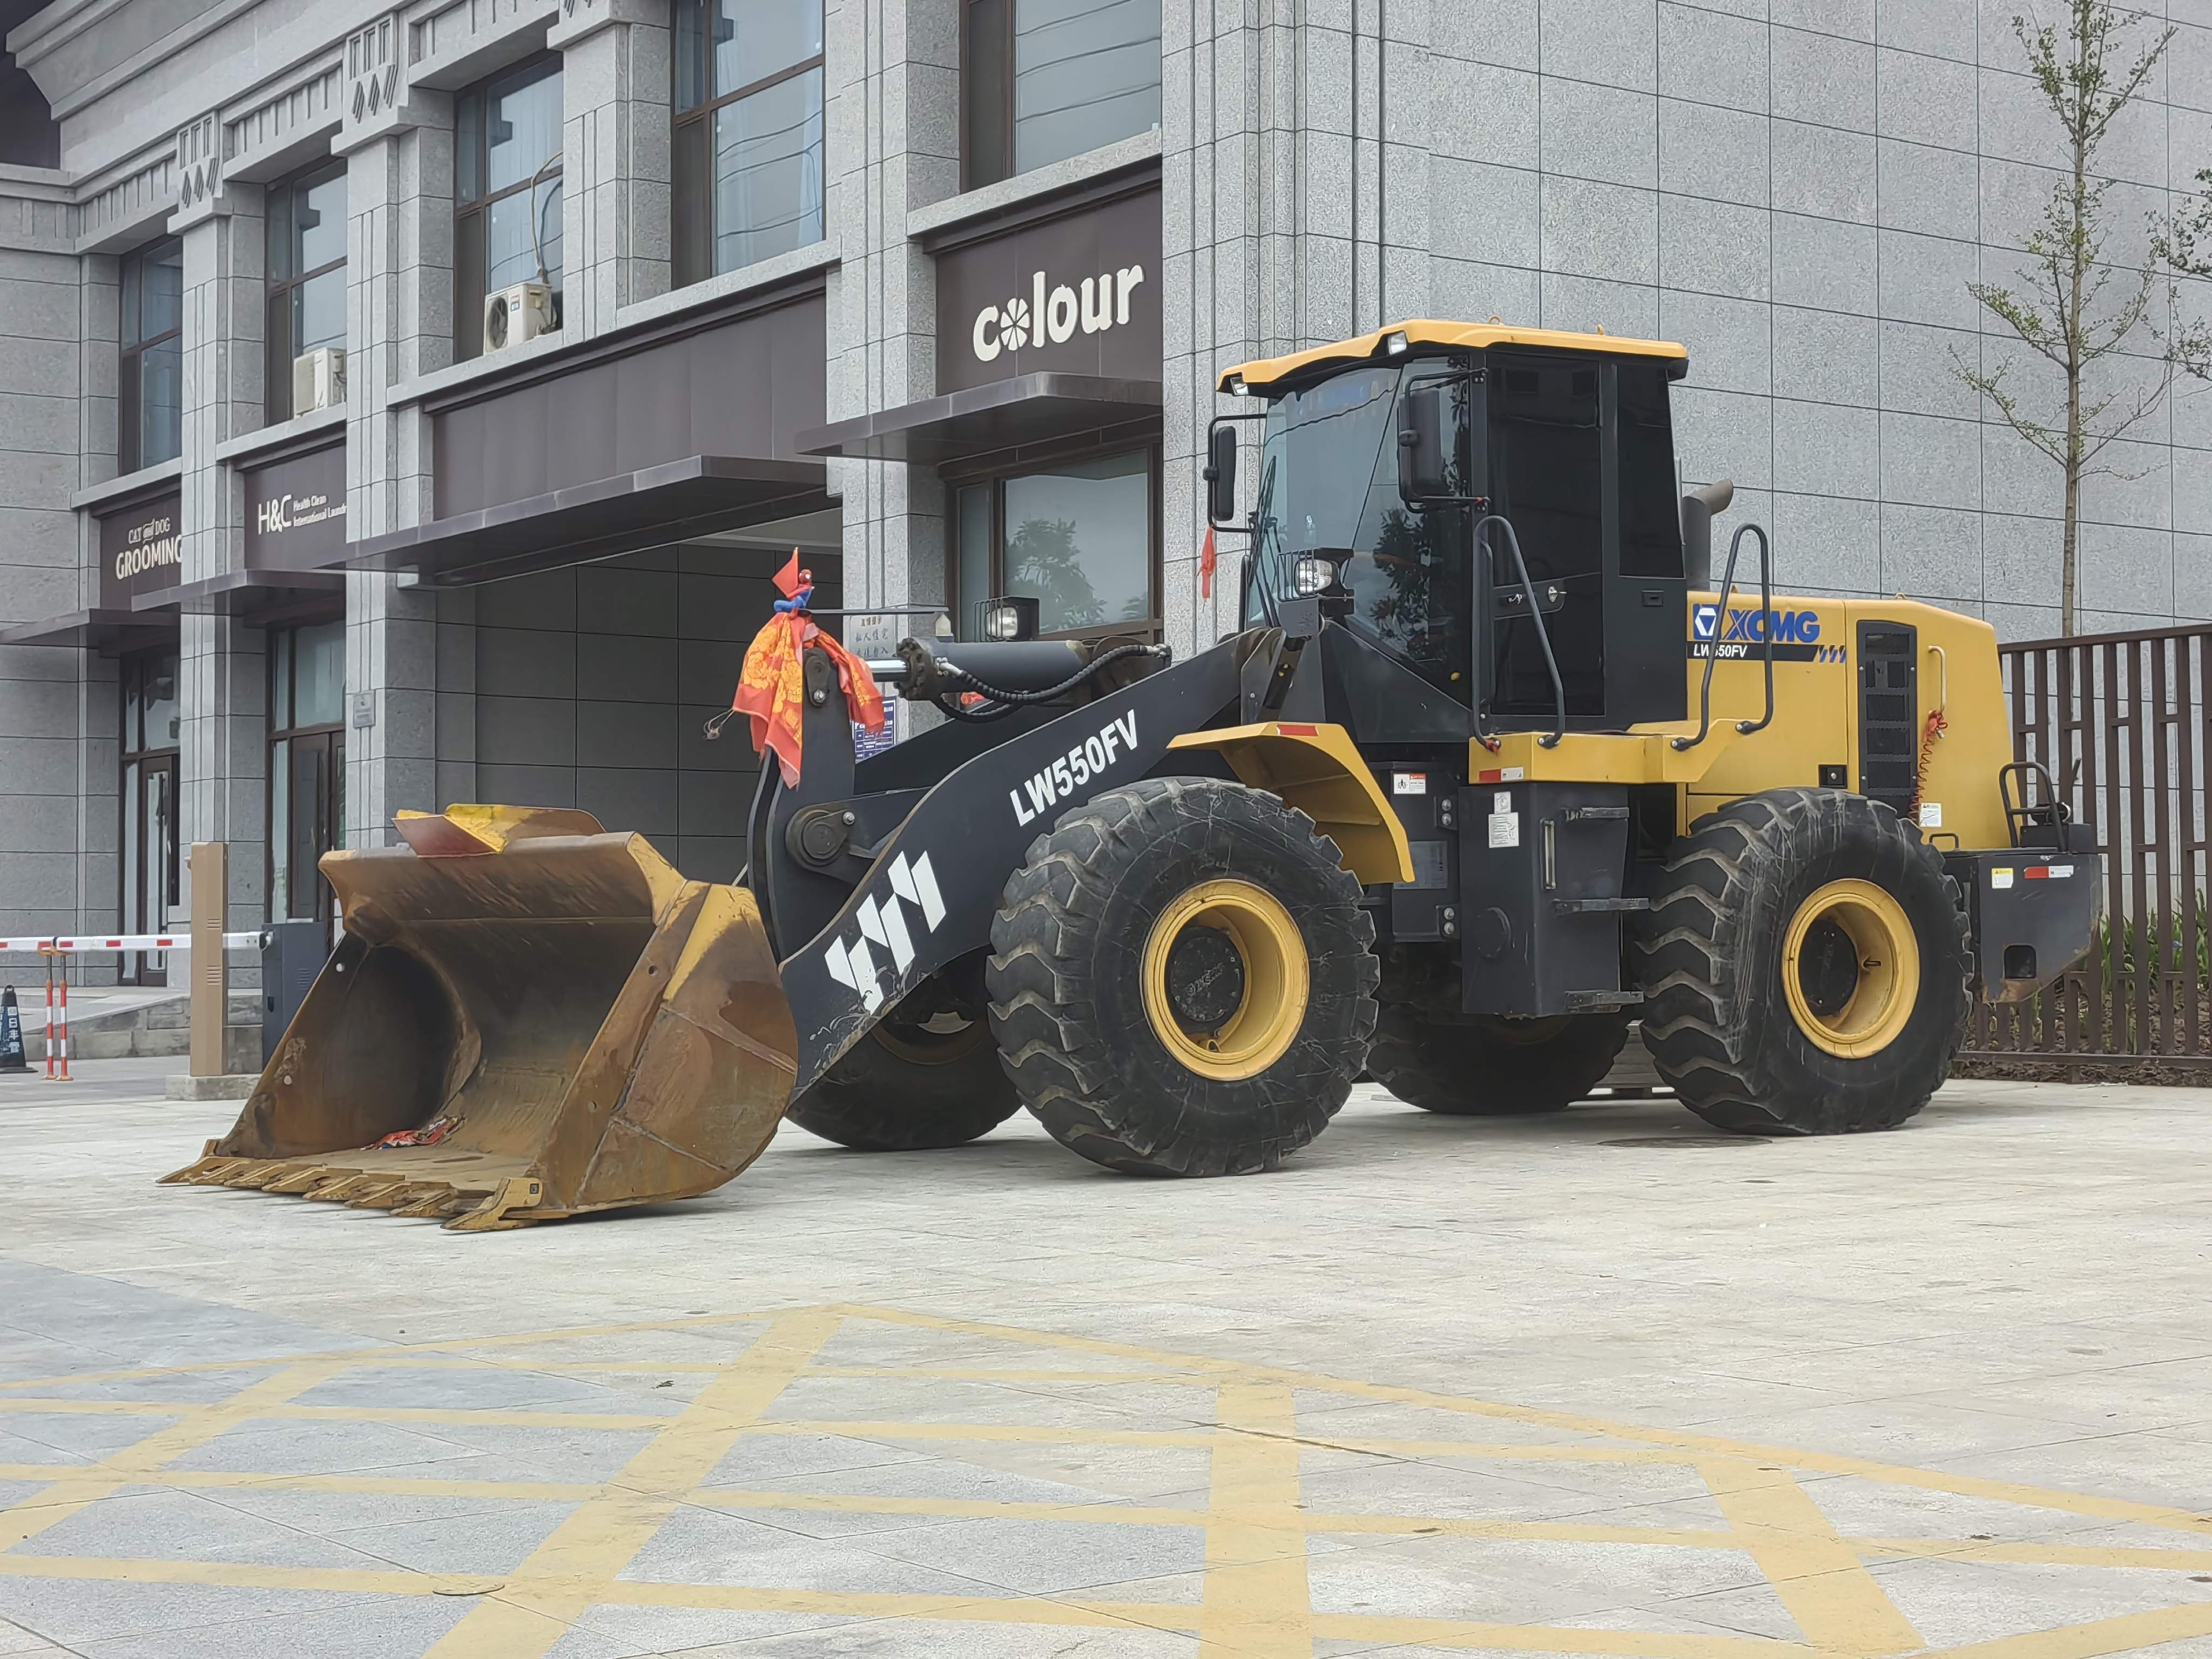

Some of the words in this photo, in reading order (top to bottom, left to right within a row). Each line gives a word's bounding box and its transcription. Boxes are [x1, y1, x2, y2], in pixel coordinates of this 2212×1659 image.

[973, 265, 1145, 362] colour
[258, 494, 292, 535] H&C
[293, 497, 311, 512] Health
[327, 502, 347, 518] Laundr
[129, 527, 142, 544] CAT
[155, 517, 171, 536] DOG
[116, 534, 182, 579] GROOMING
[1723, 609, 1820, 643] XCMG
[1009, 709, 1137, 827] LW550FV
